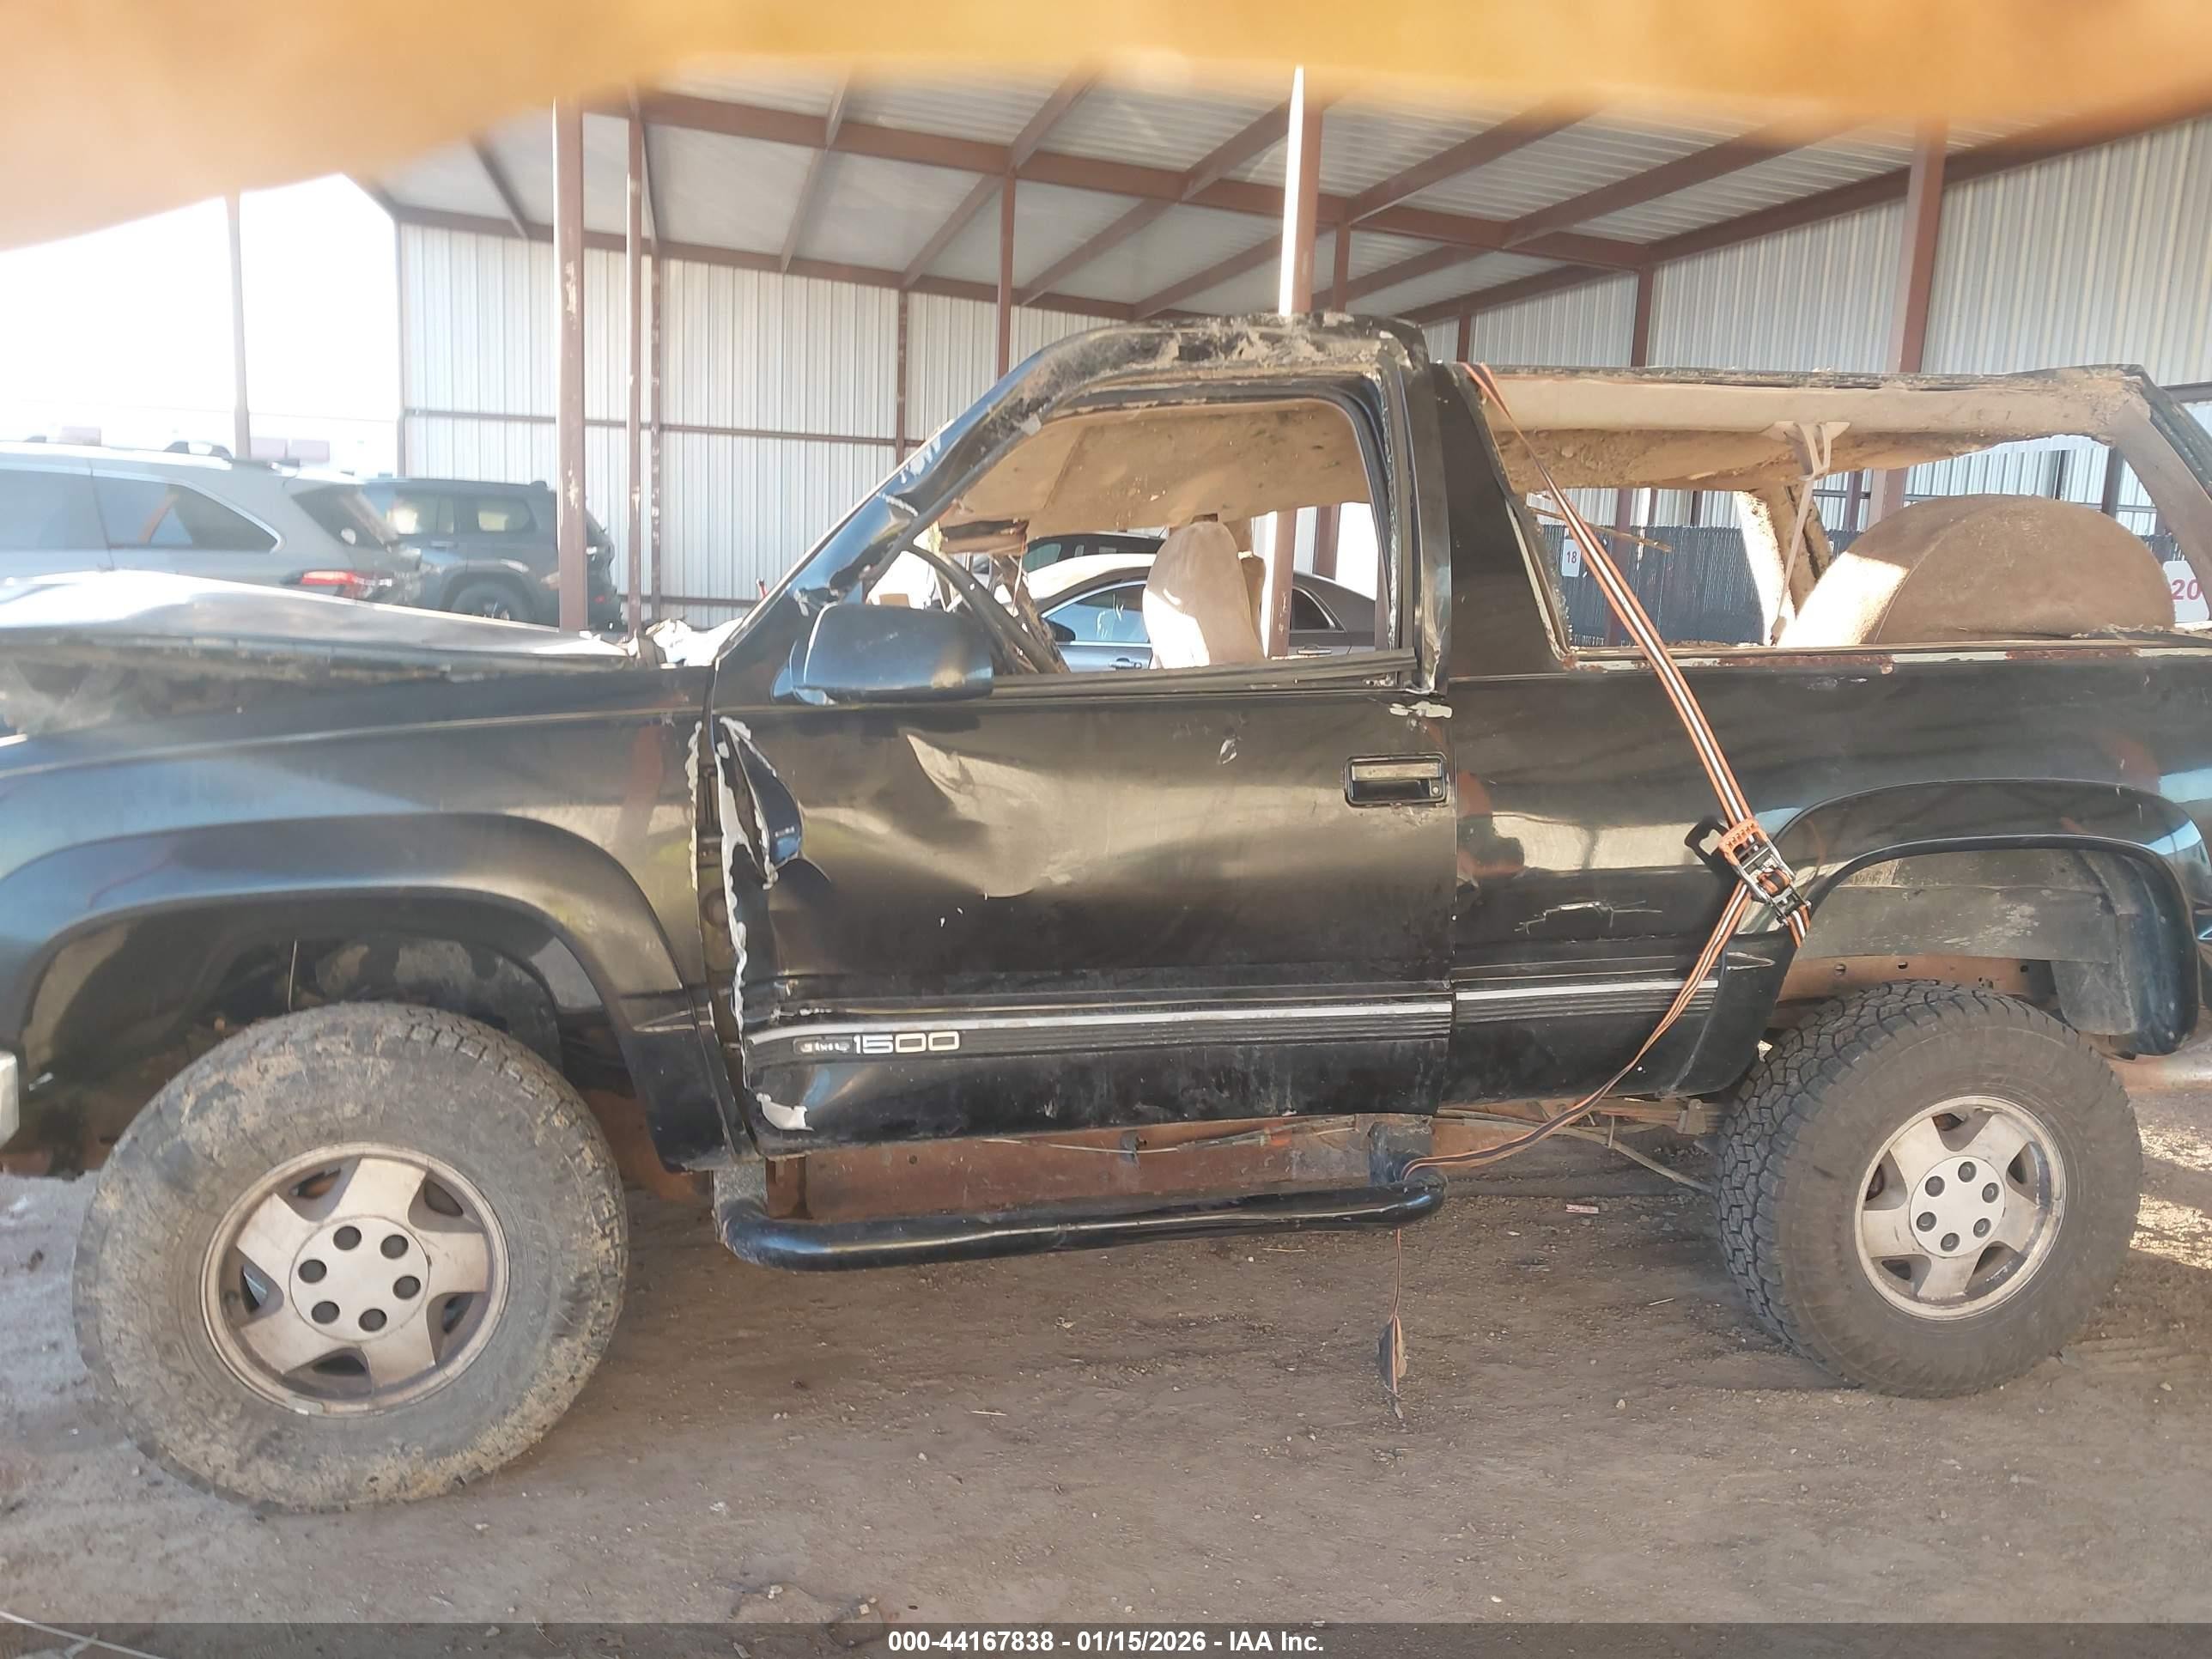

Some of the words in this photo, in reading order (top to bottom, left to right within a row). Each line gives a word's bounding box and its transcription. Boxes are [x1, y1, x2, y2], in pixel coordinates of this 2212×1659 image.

[1566, 550, 1577, 564] 18
[2172, 578, 2202, 601] 20
[853, 1030, 960, 1054] 1500
